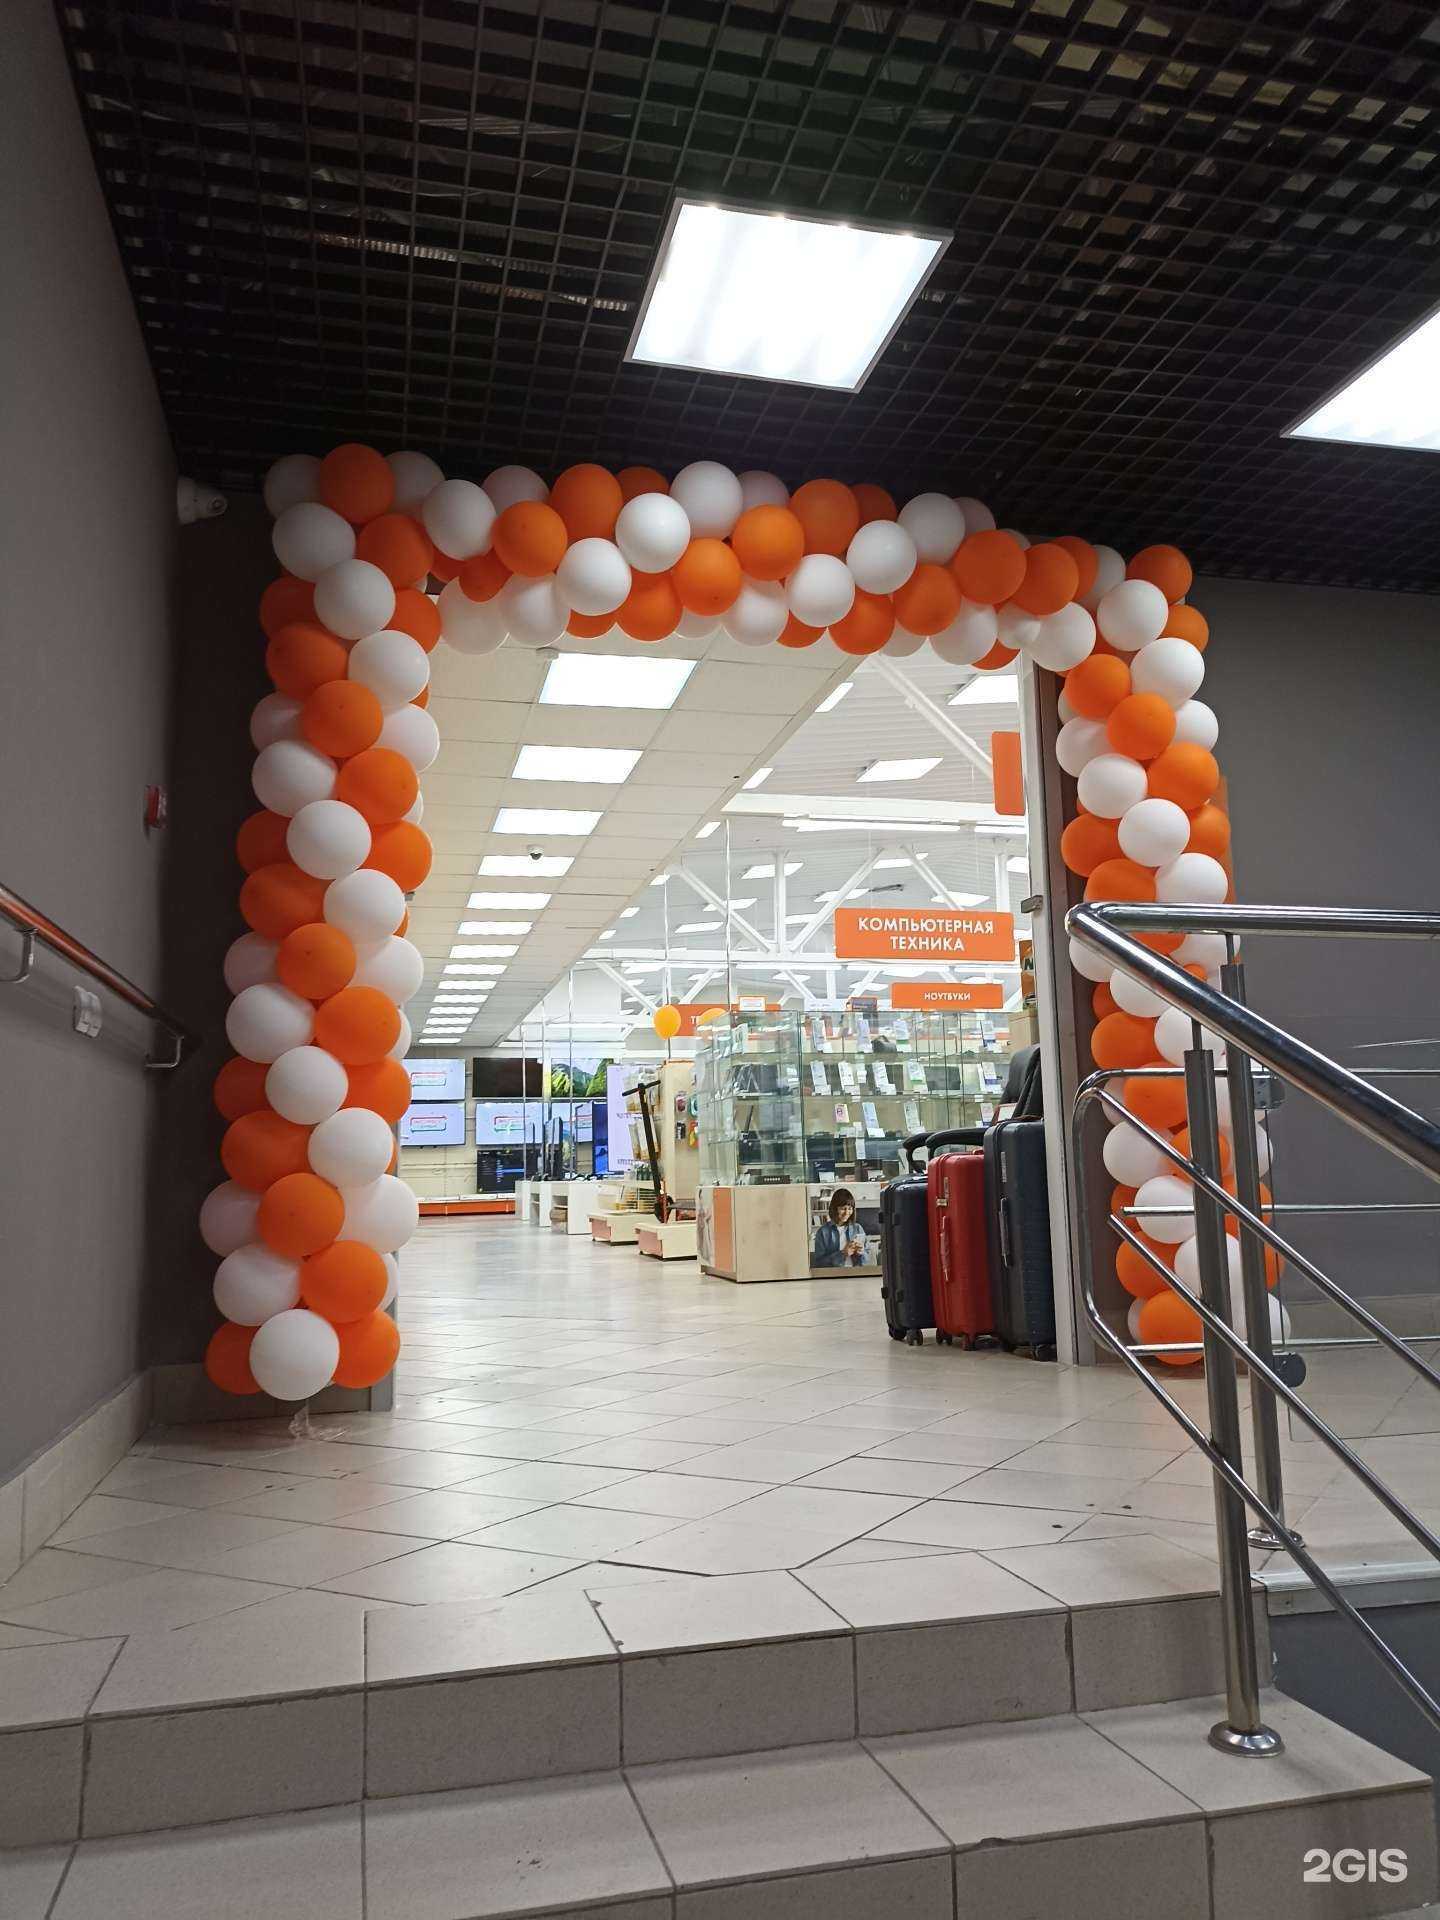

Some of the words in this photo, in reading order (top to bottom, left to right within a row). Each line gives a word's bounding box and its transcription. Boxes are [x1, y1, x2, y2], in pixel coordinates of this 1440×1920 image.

[858, 917, 994, 934] КОМПЬЮТЕРНАЯ
[890, 935, 965, 952] ТЕХНИКА
[924, 992, 971, 1001] НОУТБУКИ
